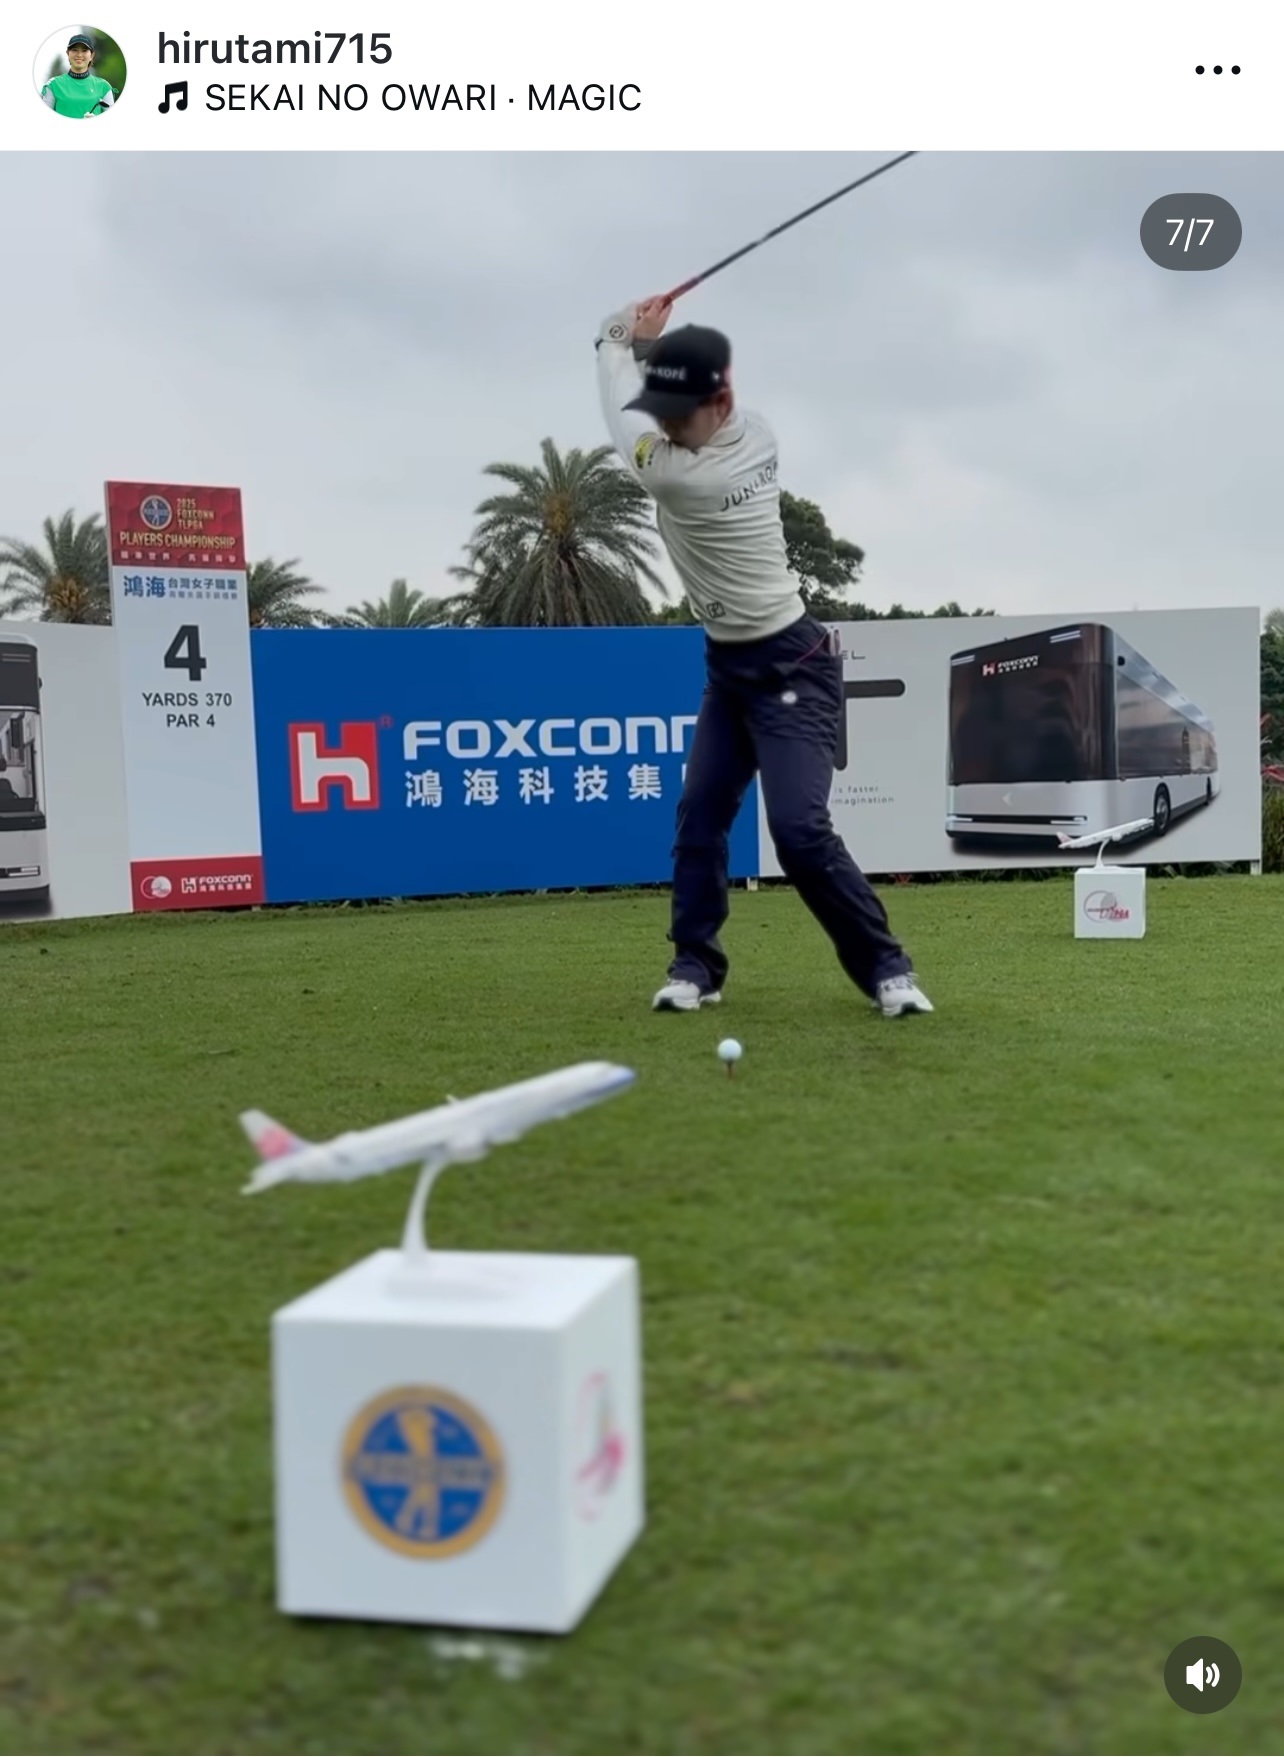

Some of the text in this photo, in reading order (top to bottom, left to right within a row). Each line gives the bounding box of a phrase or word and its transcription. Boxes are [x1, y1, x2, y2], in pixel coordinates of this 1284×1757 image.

[176, 509, 215, 520] FOXCONN
[120, 532, 236, 549] PLAYERS CHAMPIONSHIP
[123, 575, 166, 598] 鴻海
[163, 624, 207, 681] 4
[141, 692, 232, 707] YARDS 370
[166, 713, 216, 728] PAR 4
[404, 763, 688, 808] 鴻海科技集
[199, 874, 252, 884] FOXCONN
